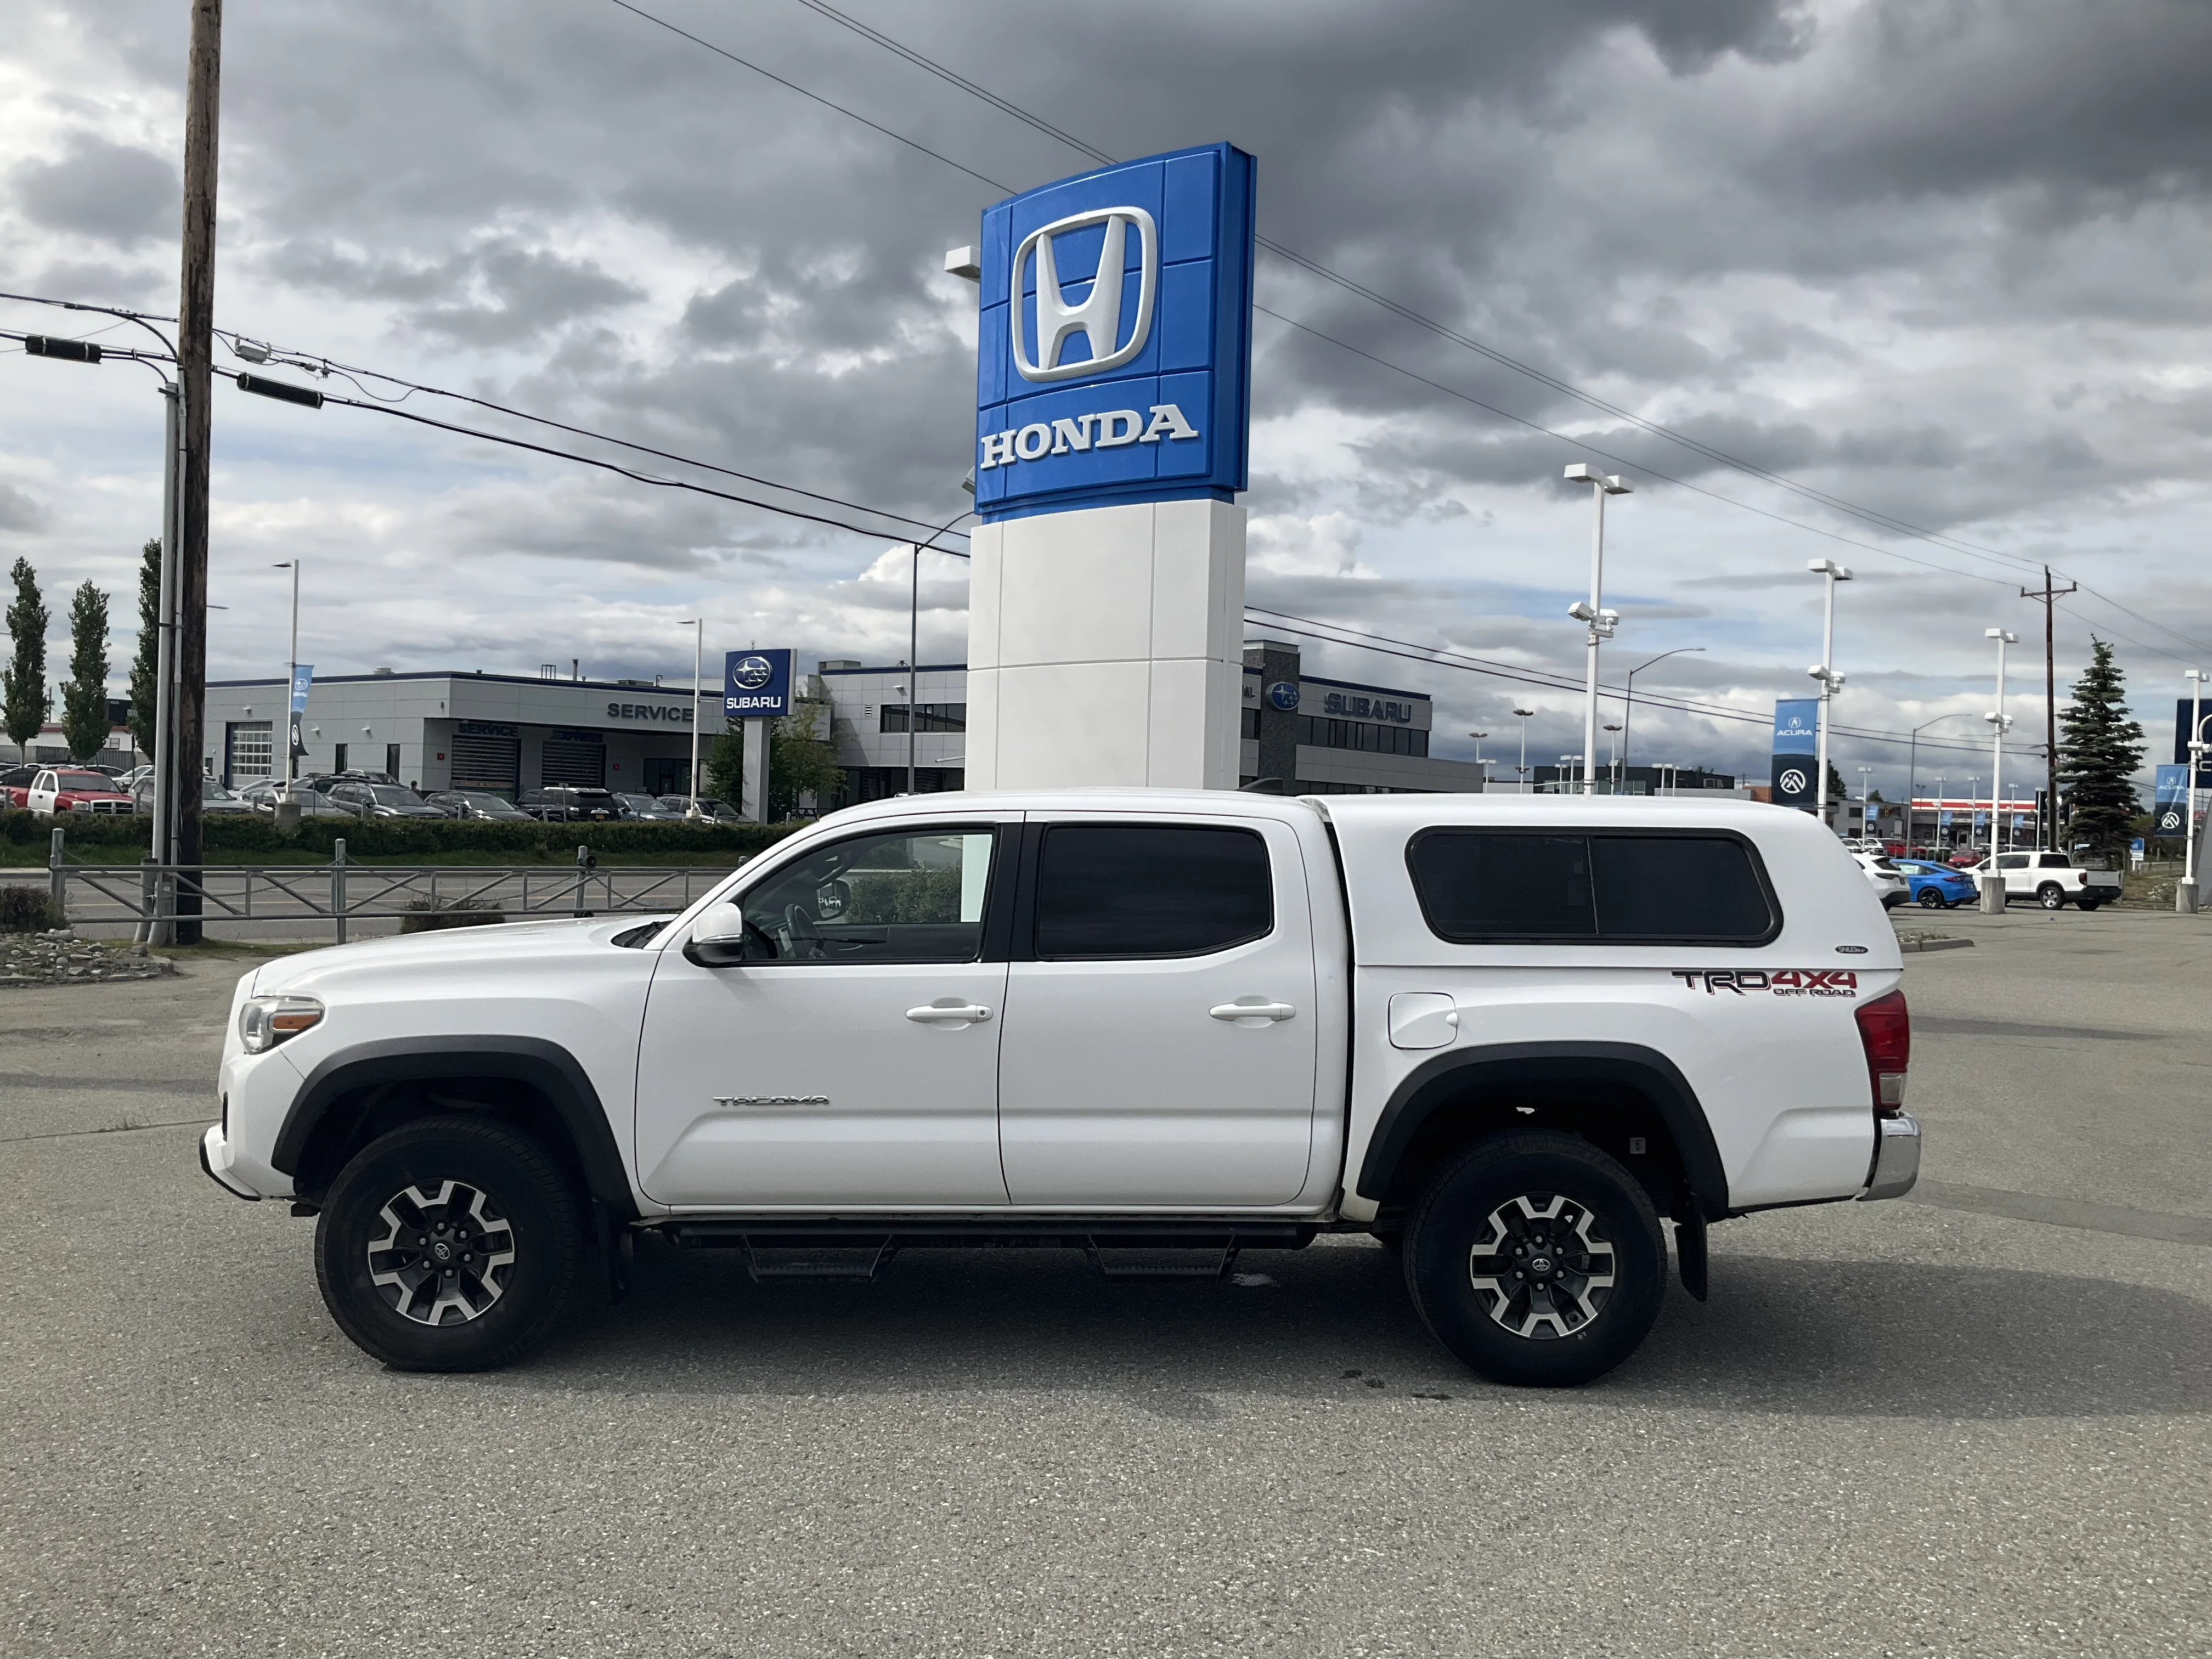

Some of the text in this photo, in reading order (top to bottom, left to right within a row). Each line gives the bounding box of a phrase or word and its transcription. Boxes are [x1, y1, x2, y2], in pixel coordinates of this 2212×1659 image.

[980, 404, 1199, 470] HONDA
[1242, 685, 1255, 698] AL
[726, 696, 781, 709] SUBARU
[1324, 692, 1412, 723] SUBARU
[607, 703, 694, 722] SERVICE
[459, 723, 519, 737] SERVICE
[1671, 970, 1771, 996] TRD
[1809, 989, 1857, 997] ROAD
[713, 1096, 830, 1106] TACOMA
